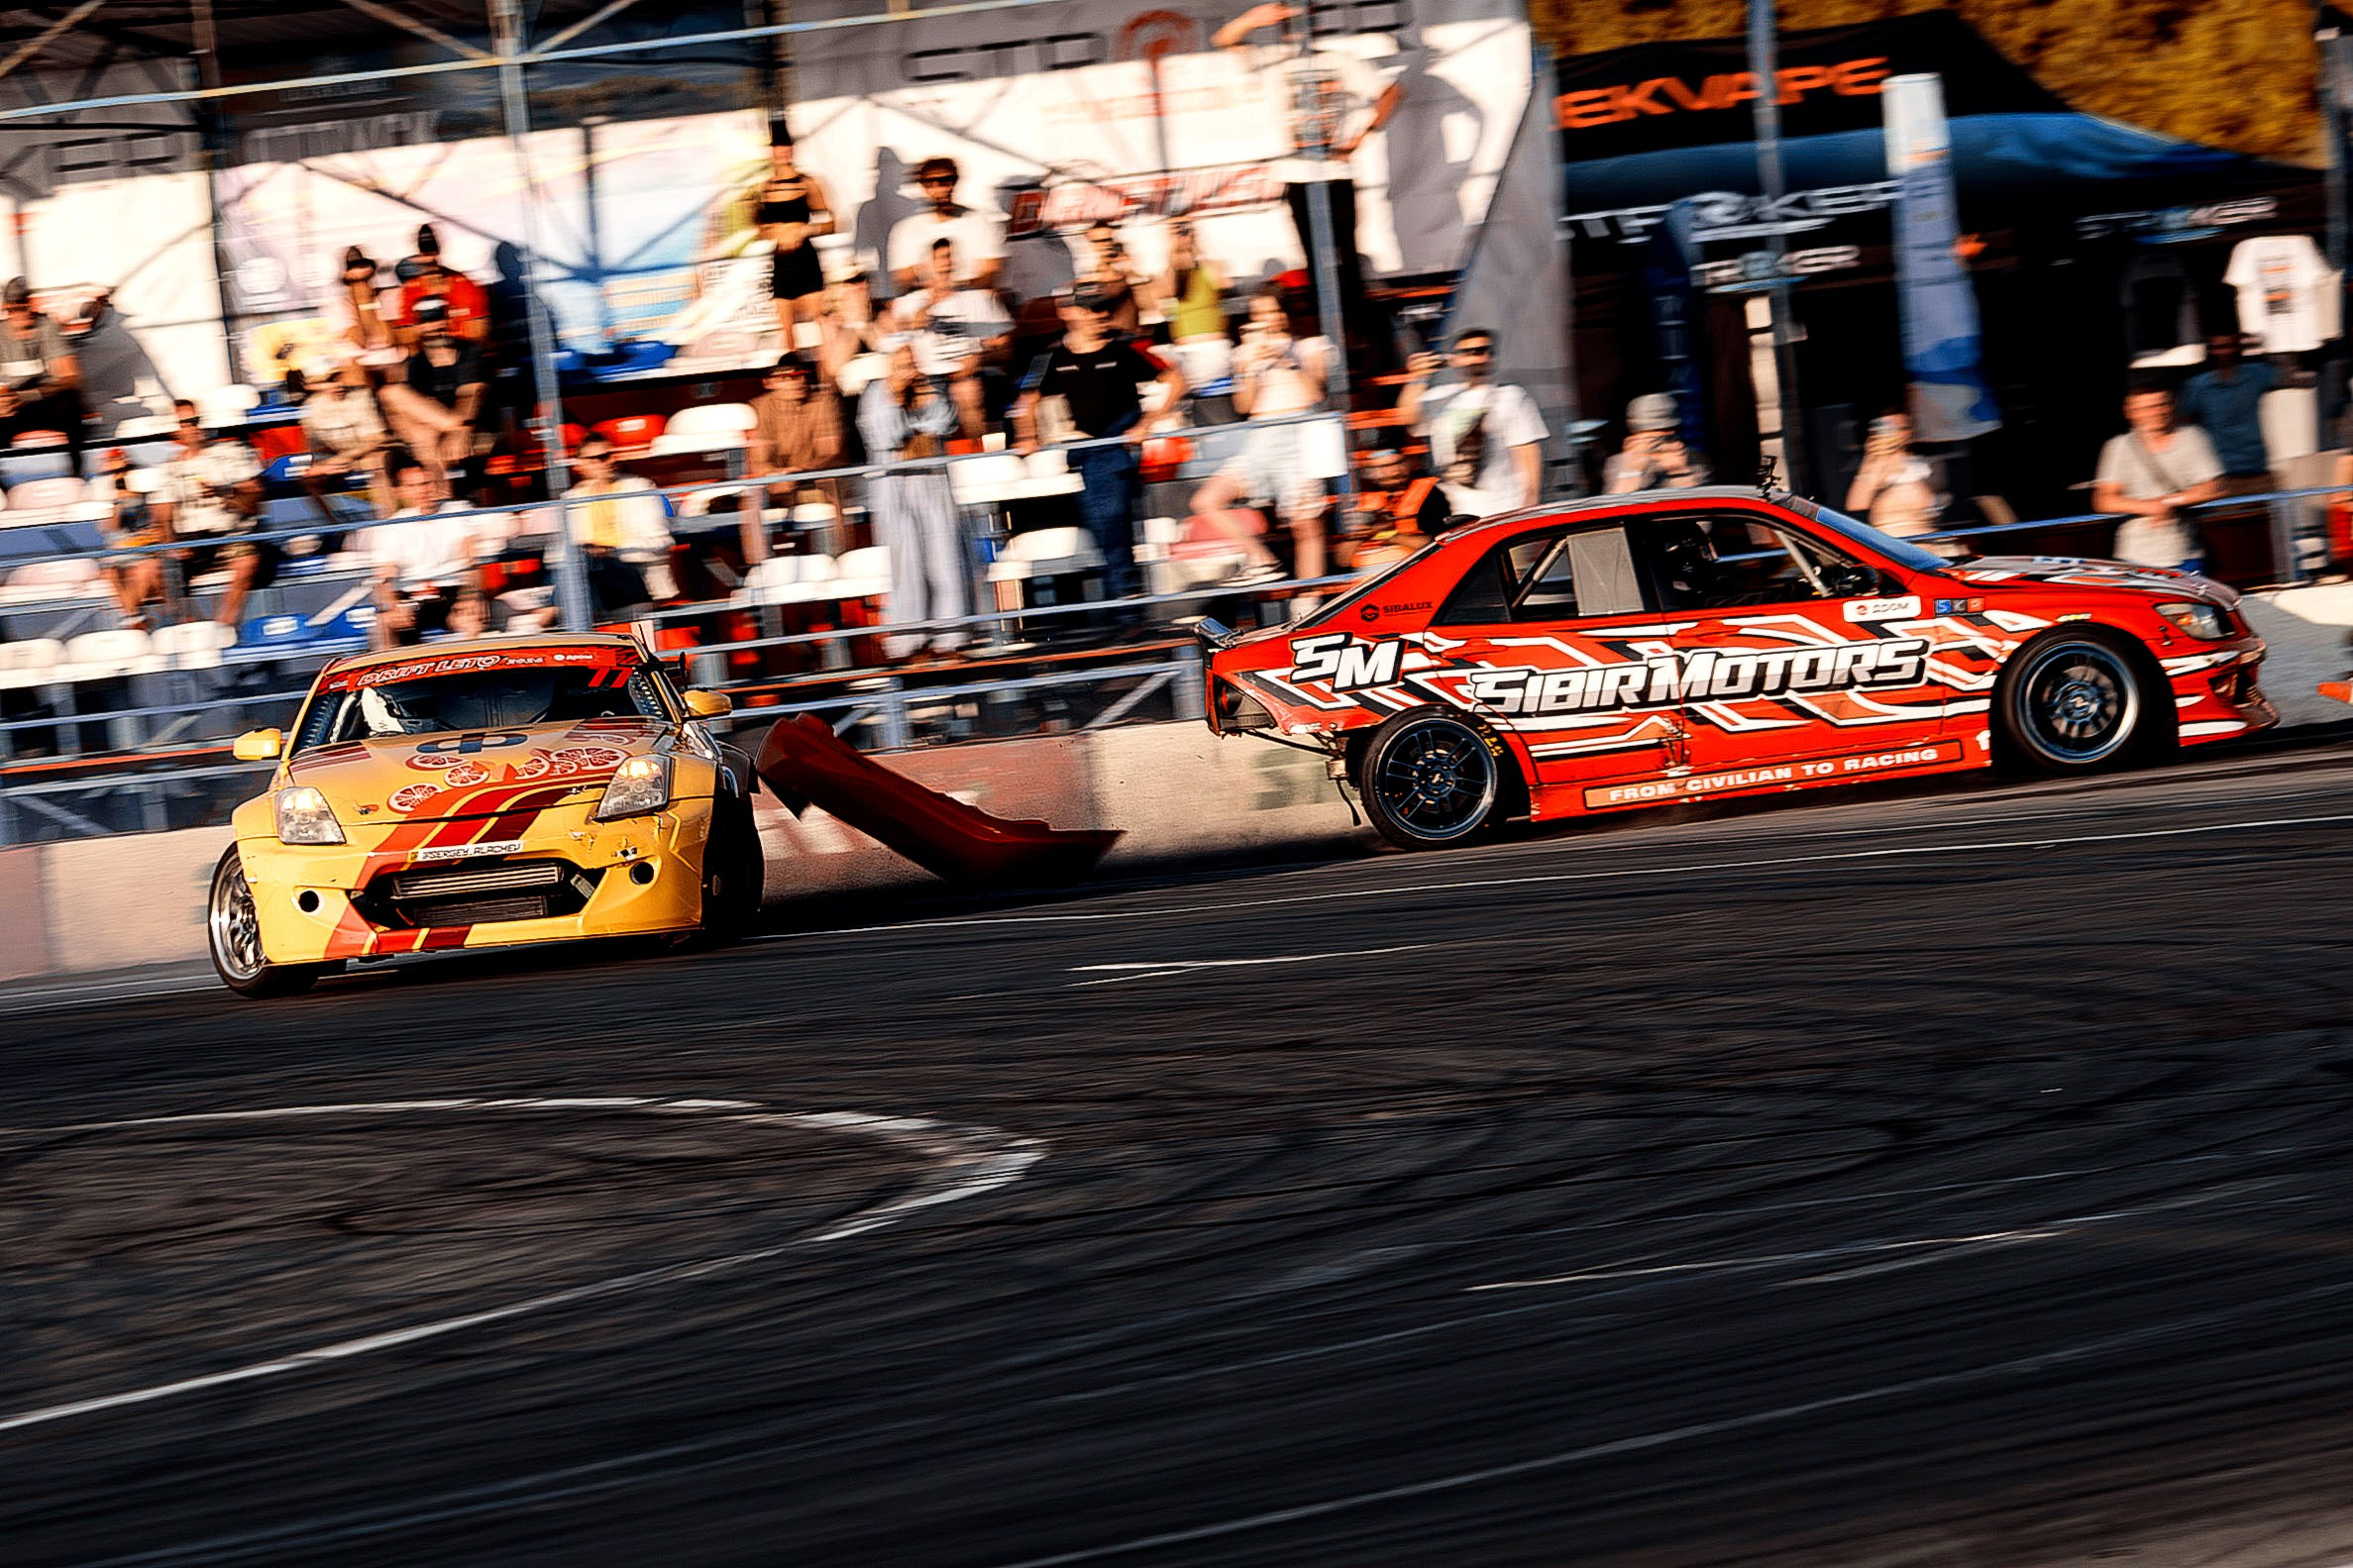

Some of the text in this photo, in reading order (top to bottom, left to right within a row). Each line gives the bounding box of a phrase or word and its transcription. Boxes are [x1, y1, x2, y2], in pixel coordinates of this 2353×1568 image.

[1550, 55, 1891, 131] EKVAPE
[1383, 601, 1433, 613] SIBALUX
[358, 661, 435, 686] DRIFT
[435, 655, 501, 672] LETO
[588, 667, 633, 688] 77
[1291, 633, 1402, 690] SM
[1609, 748, 1938, 801] FROM CIVILIAN TO RACING
